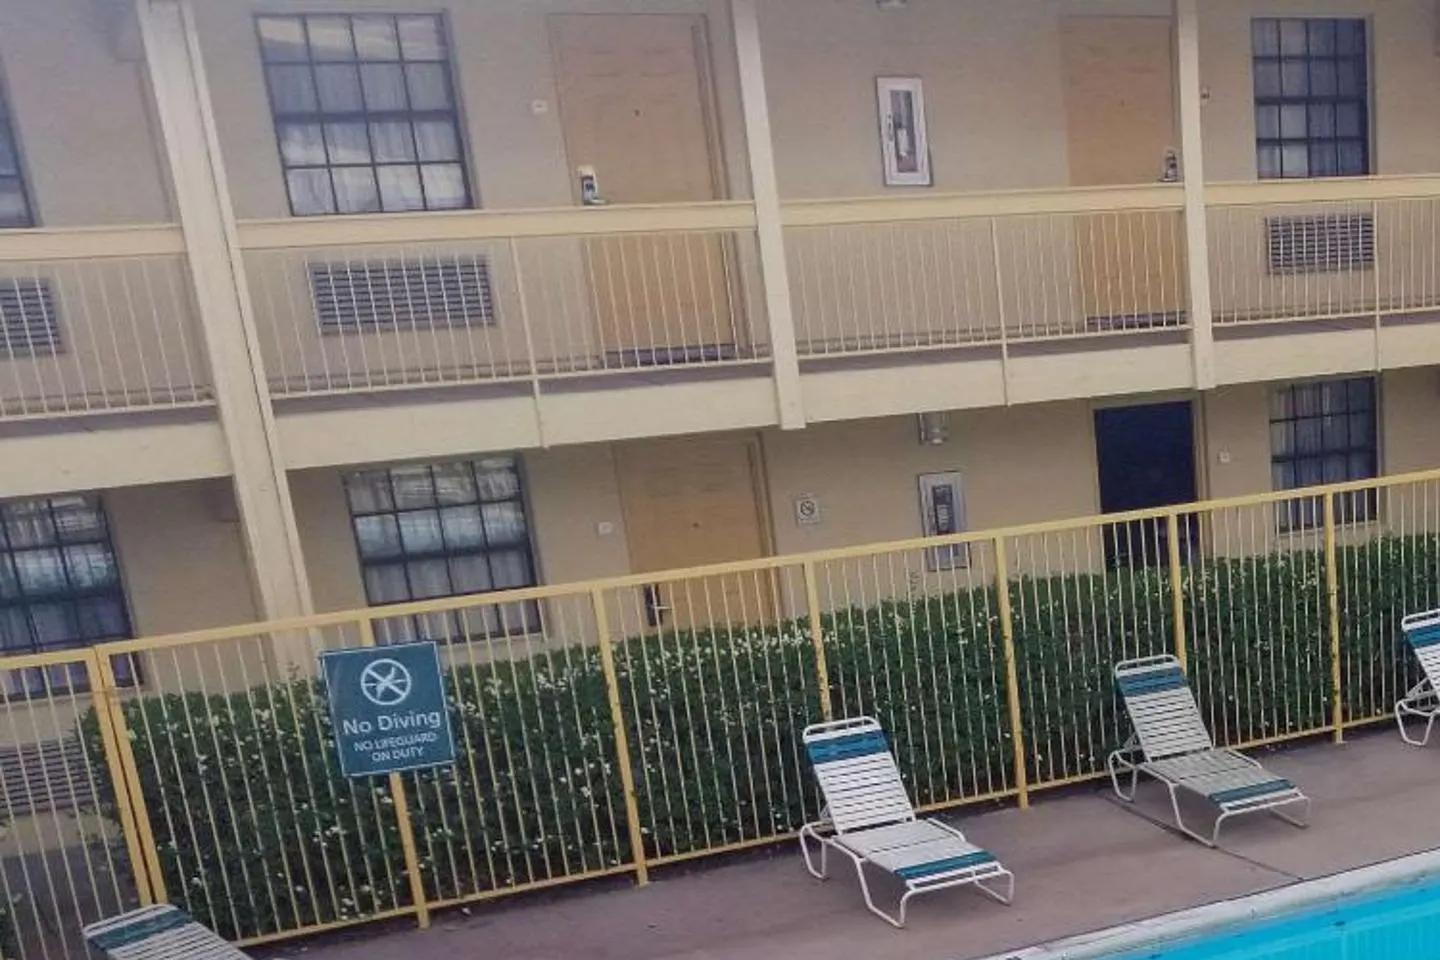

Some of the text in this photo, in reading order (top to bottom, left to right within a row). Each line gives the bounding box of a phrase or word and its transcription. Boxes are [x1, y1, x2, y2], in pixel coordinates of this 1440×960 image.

[343, 711, 440, 735] No Diving
[353, 732, 437, 752] NO LIFEGUARD
[371, 746, 424, 761] ON DUTY
